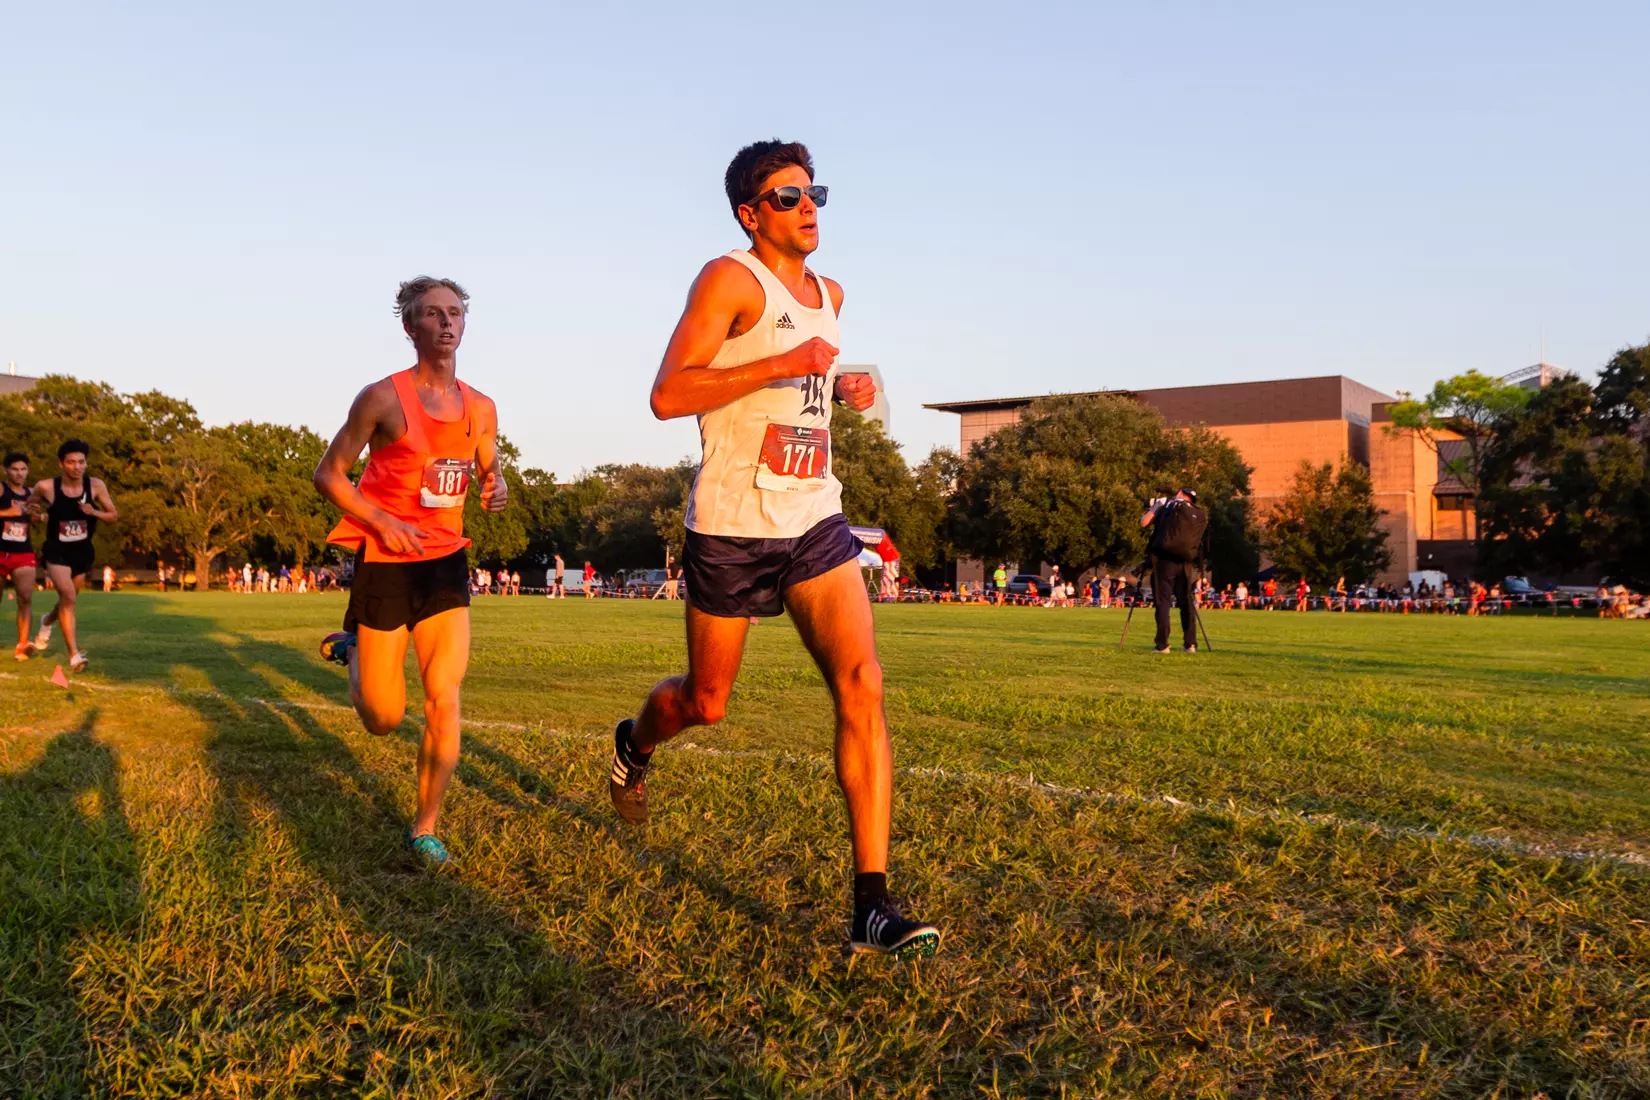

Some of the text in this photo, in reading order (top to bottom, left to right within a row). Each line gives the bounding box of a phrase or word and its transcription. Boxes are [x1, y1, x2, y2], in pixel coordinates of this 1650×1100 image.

[775, 322, 796, 330] adidas
[782, 444, 816, 476] 171
[437, 471, 463, 494] 181
